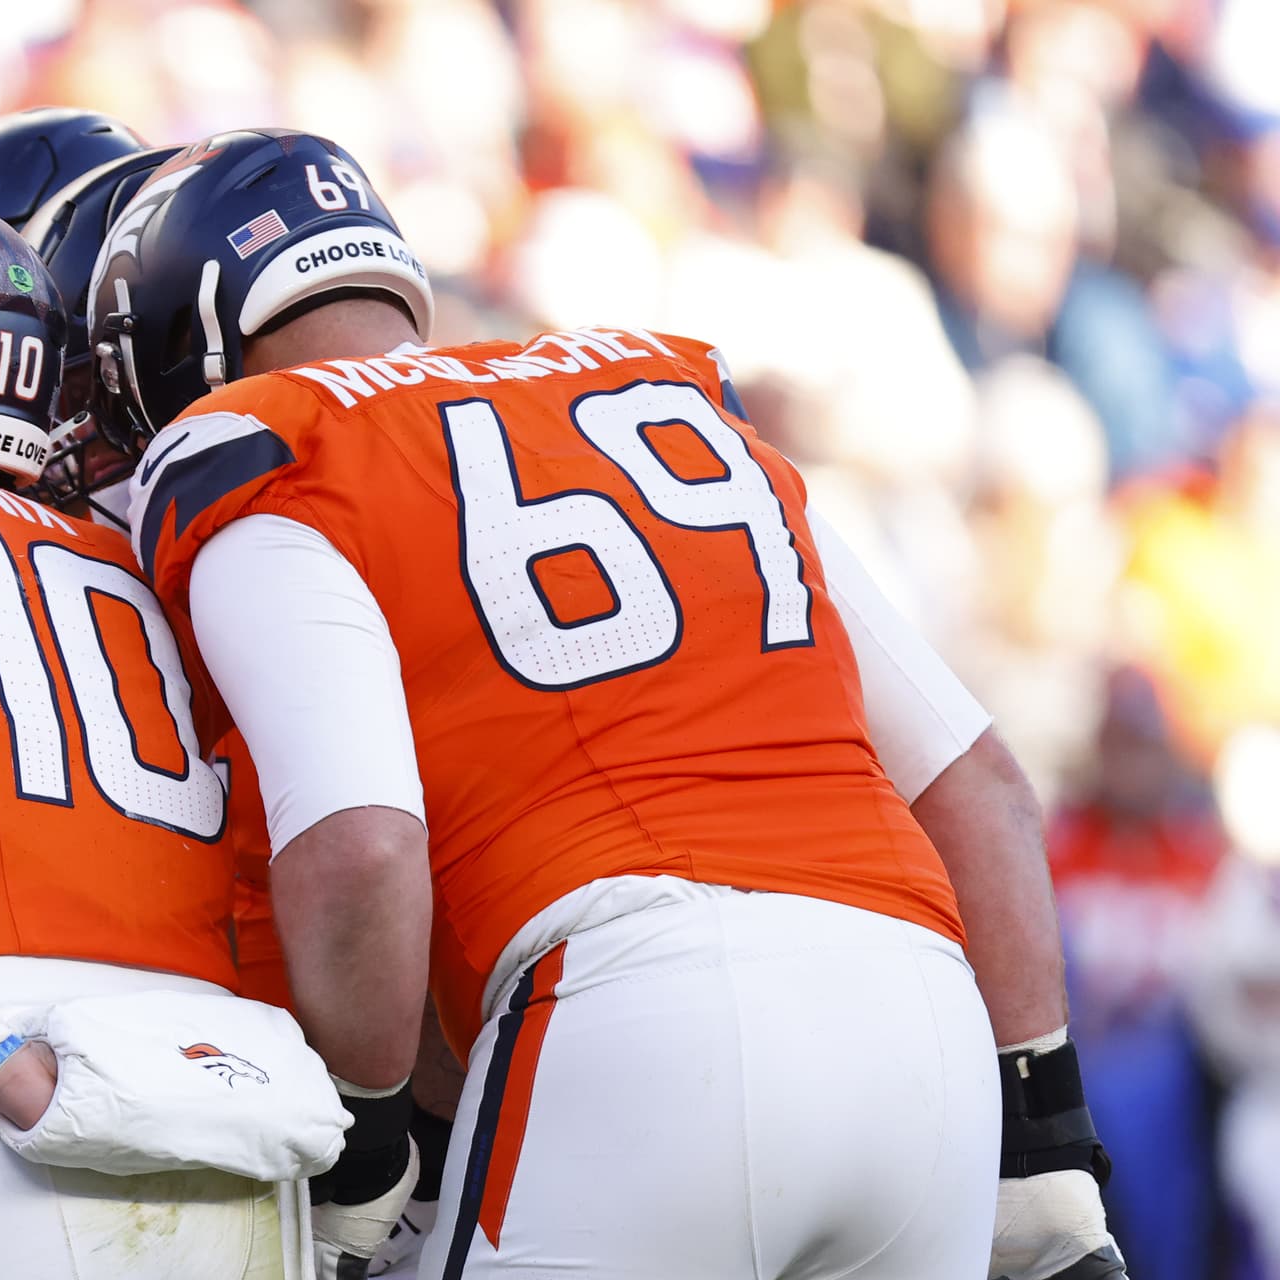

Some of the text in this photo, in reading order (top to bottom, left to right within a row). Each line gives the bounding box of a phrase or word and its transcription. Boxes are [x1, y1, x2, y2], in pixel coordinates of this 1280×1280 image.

[304, 163, 371, 211] 69
[295, 241, 425, 279] CHOOSE LOVE
[15, 438, 47, 465] LOVE
[436, 379, 815, 691] 69
